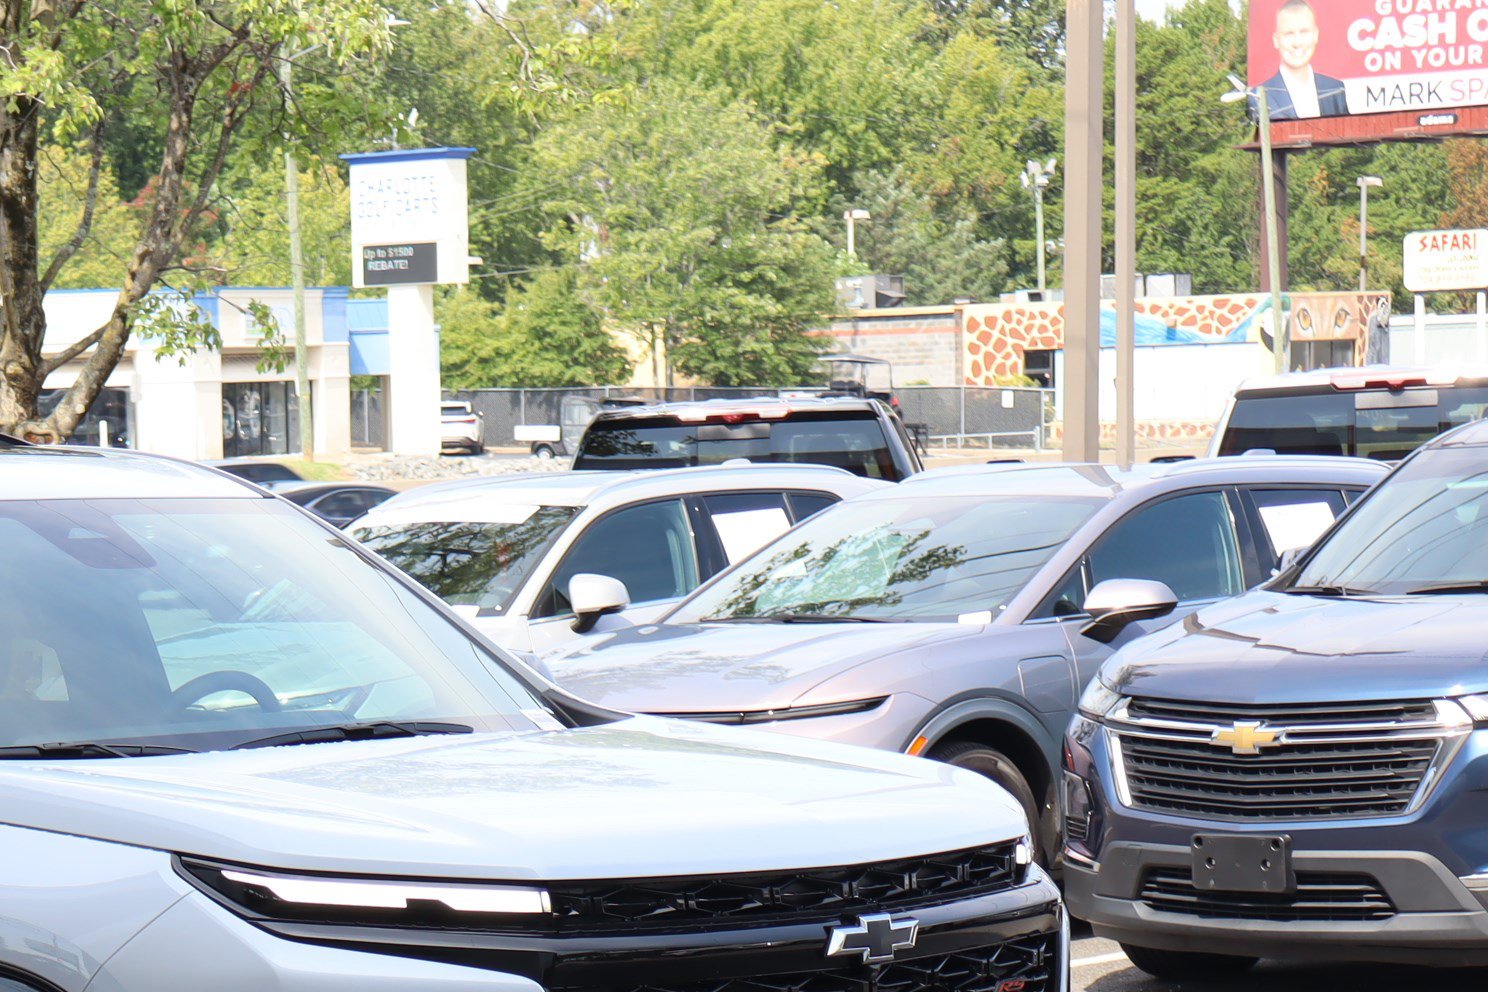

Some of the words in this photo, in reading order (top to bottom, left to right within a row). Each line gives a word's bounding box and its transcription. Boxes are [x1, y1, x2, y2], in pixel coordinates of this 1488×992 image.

[1347, 11, 1457, 50] CASH
[1364, 51, 1403, 72] ON
[1411, 44, 1483, 68] YOUR
[1366, 80, 1443, 107] MARK
[1450, 78, 1488, 102] SP
[364, 248, 376, 260] Up
[376, 248, 387, 258] to
[1418, 232, 1477, 252] SAFARI
